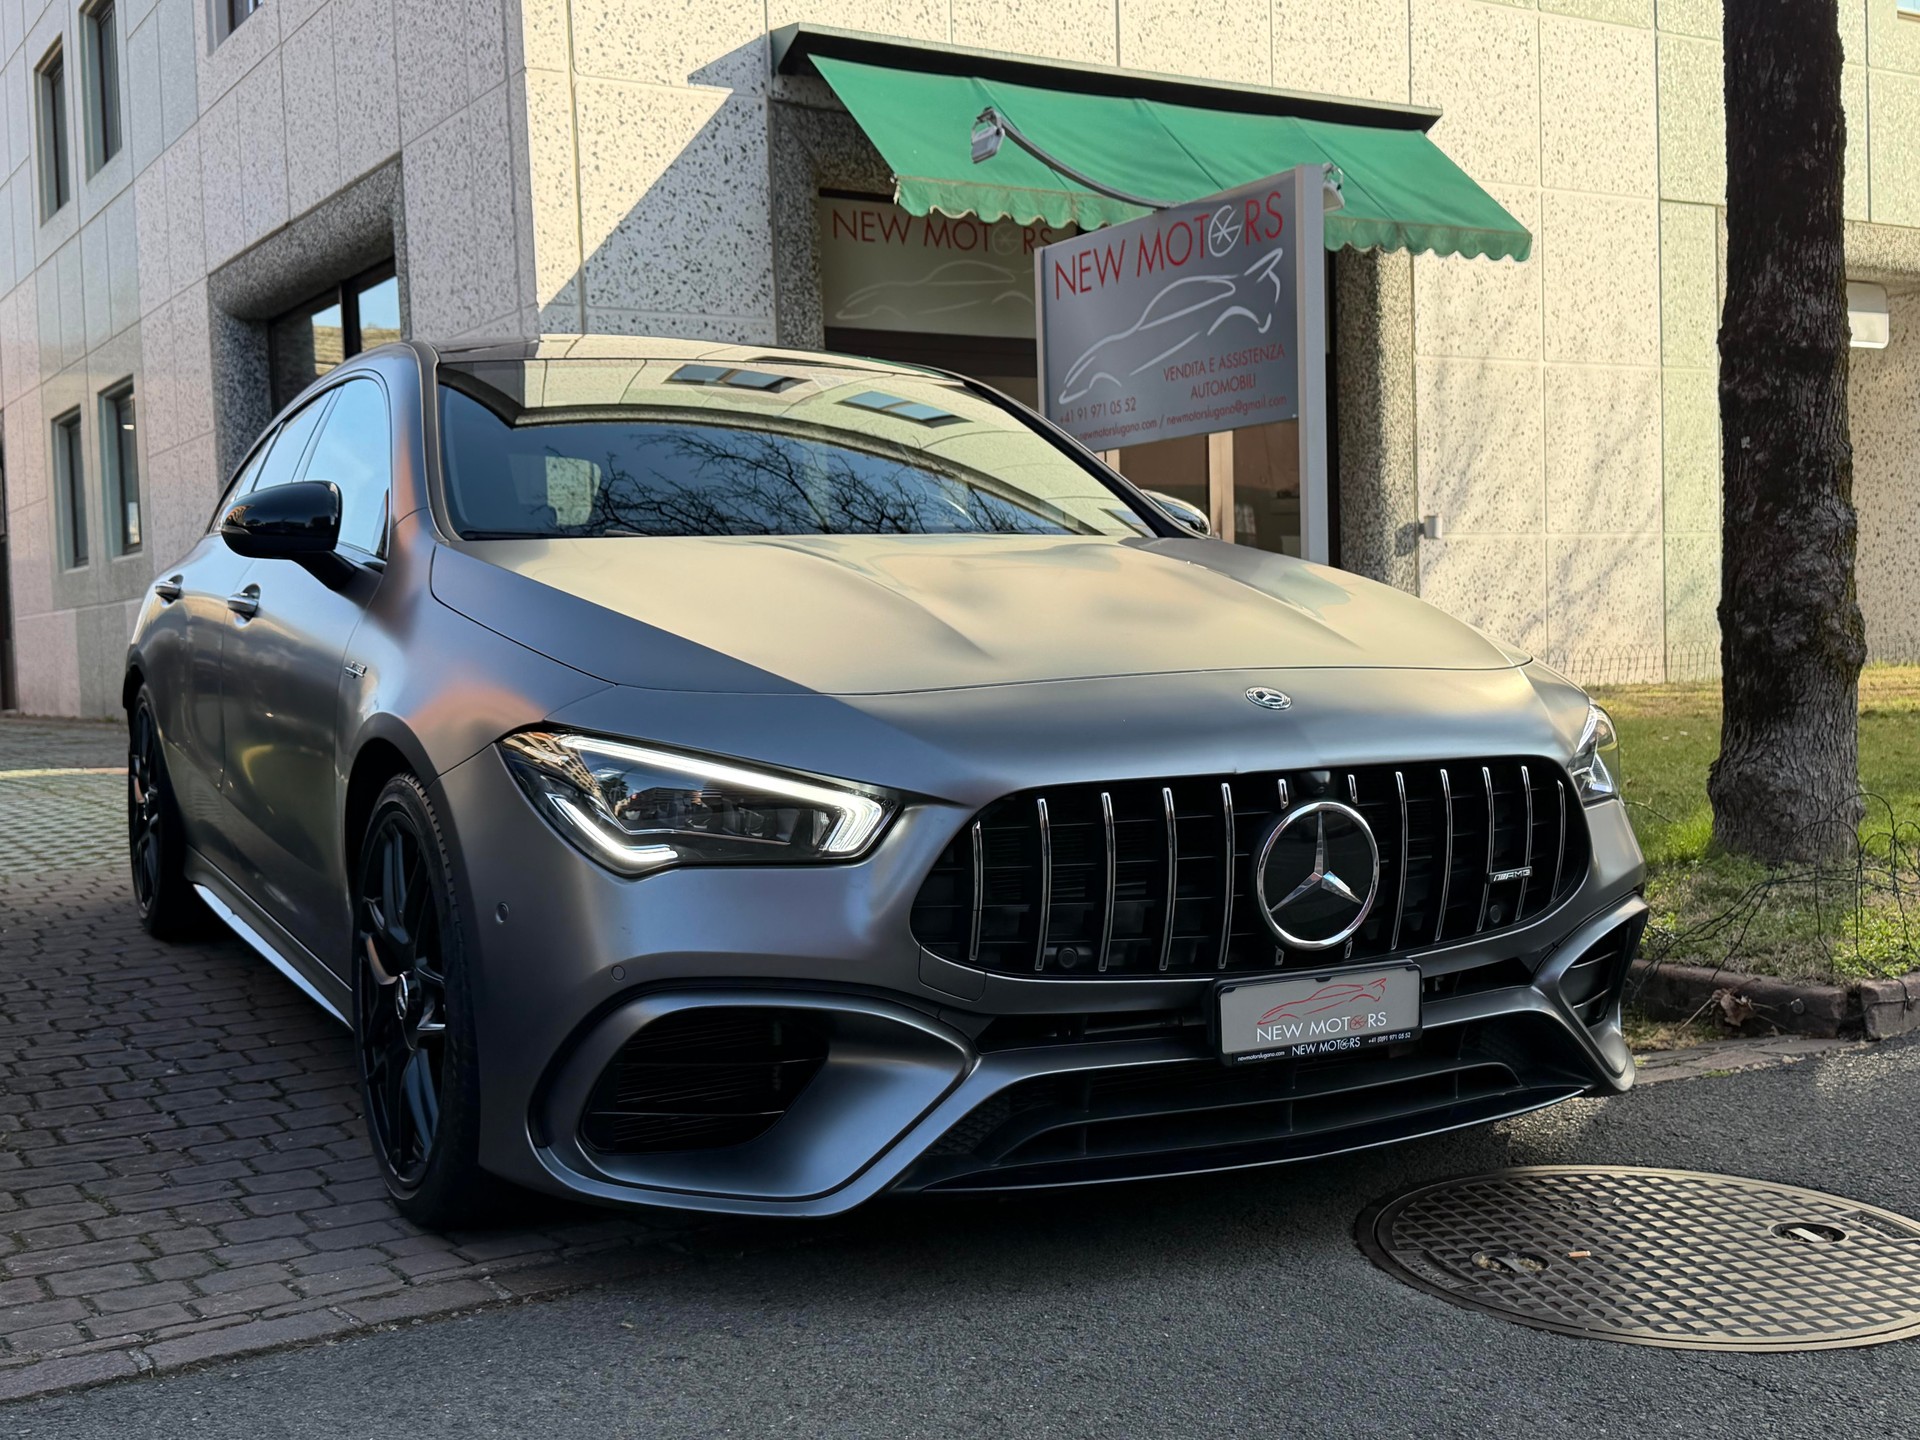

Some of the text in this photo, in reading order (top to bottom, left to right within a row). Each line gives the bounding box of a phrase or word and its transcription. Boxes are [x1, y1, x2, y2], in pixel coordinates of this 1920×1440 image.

[832, 208, 912, 245] NEW
[1055, 191, 1284, 300] NEW MOTORS
[1163, 343, 1286, 382] VENDITA E ASSISTENZA
[1191, 373, 1257, 399] AUTOMOBILI
[1060, 397, 1137, 424] +41 91 971 05 52
[1256, 1011, 1387, 1042] NEW MOTORS
[1291, 1044, 1317, 1057] NEW
[1318, 1037, 1361, 1053] MOTORS
